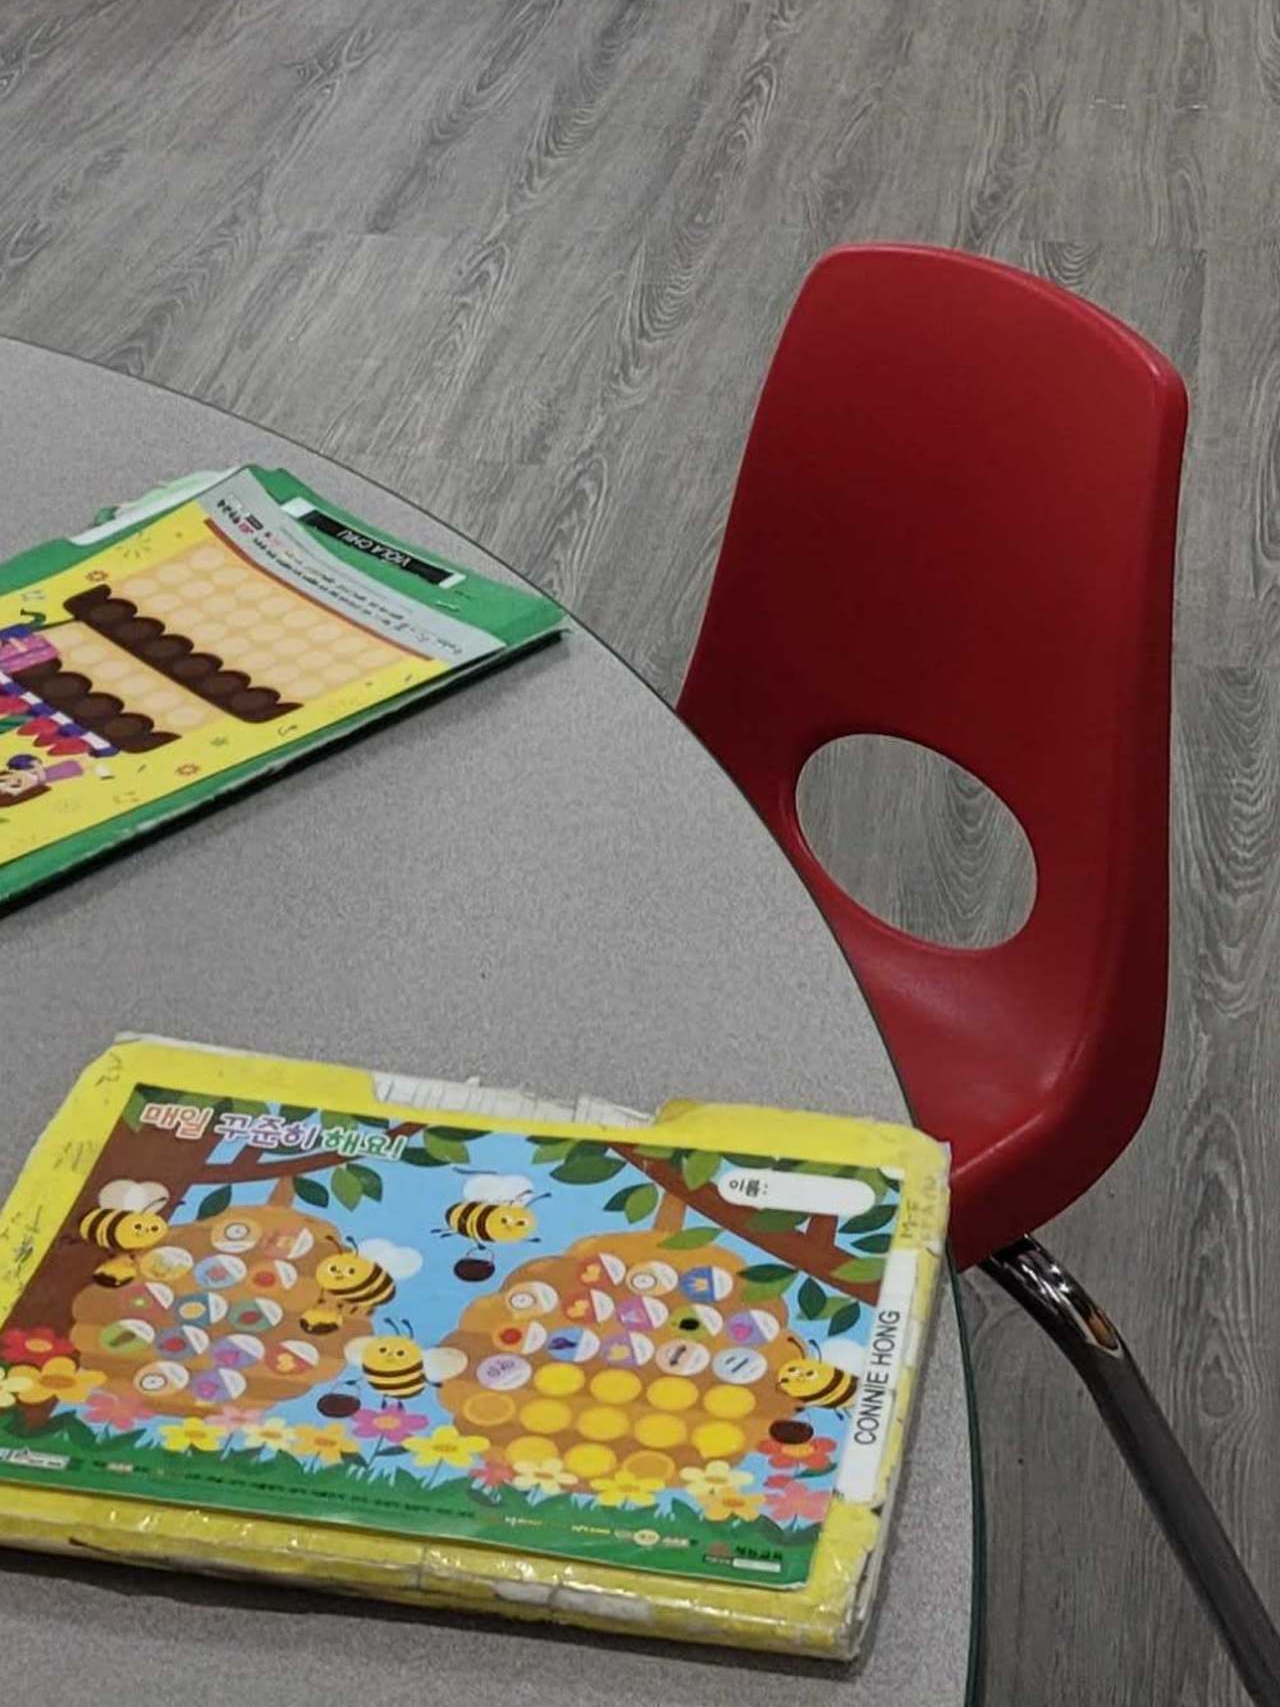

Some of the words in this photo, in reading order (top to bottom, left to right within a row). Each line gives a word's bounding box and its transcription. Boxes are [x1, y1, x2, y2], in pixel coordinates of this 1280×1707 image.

[370, 545, 412, 567] VIOLA
[140, 1103, 213, 1139] 매일
[215, 1113, 321, 1149] 꾸준히
[321, 1127, 407, 1161] 해요!
[728, 1179, 769, 1197] 이름:
[854, 1371, 889, 1446] CONNIE
[872, 1309, 901, 1368] HONG
